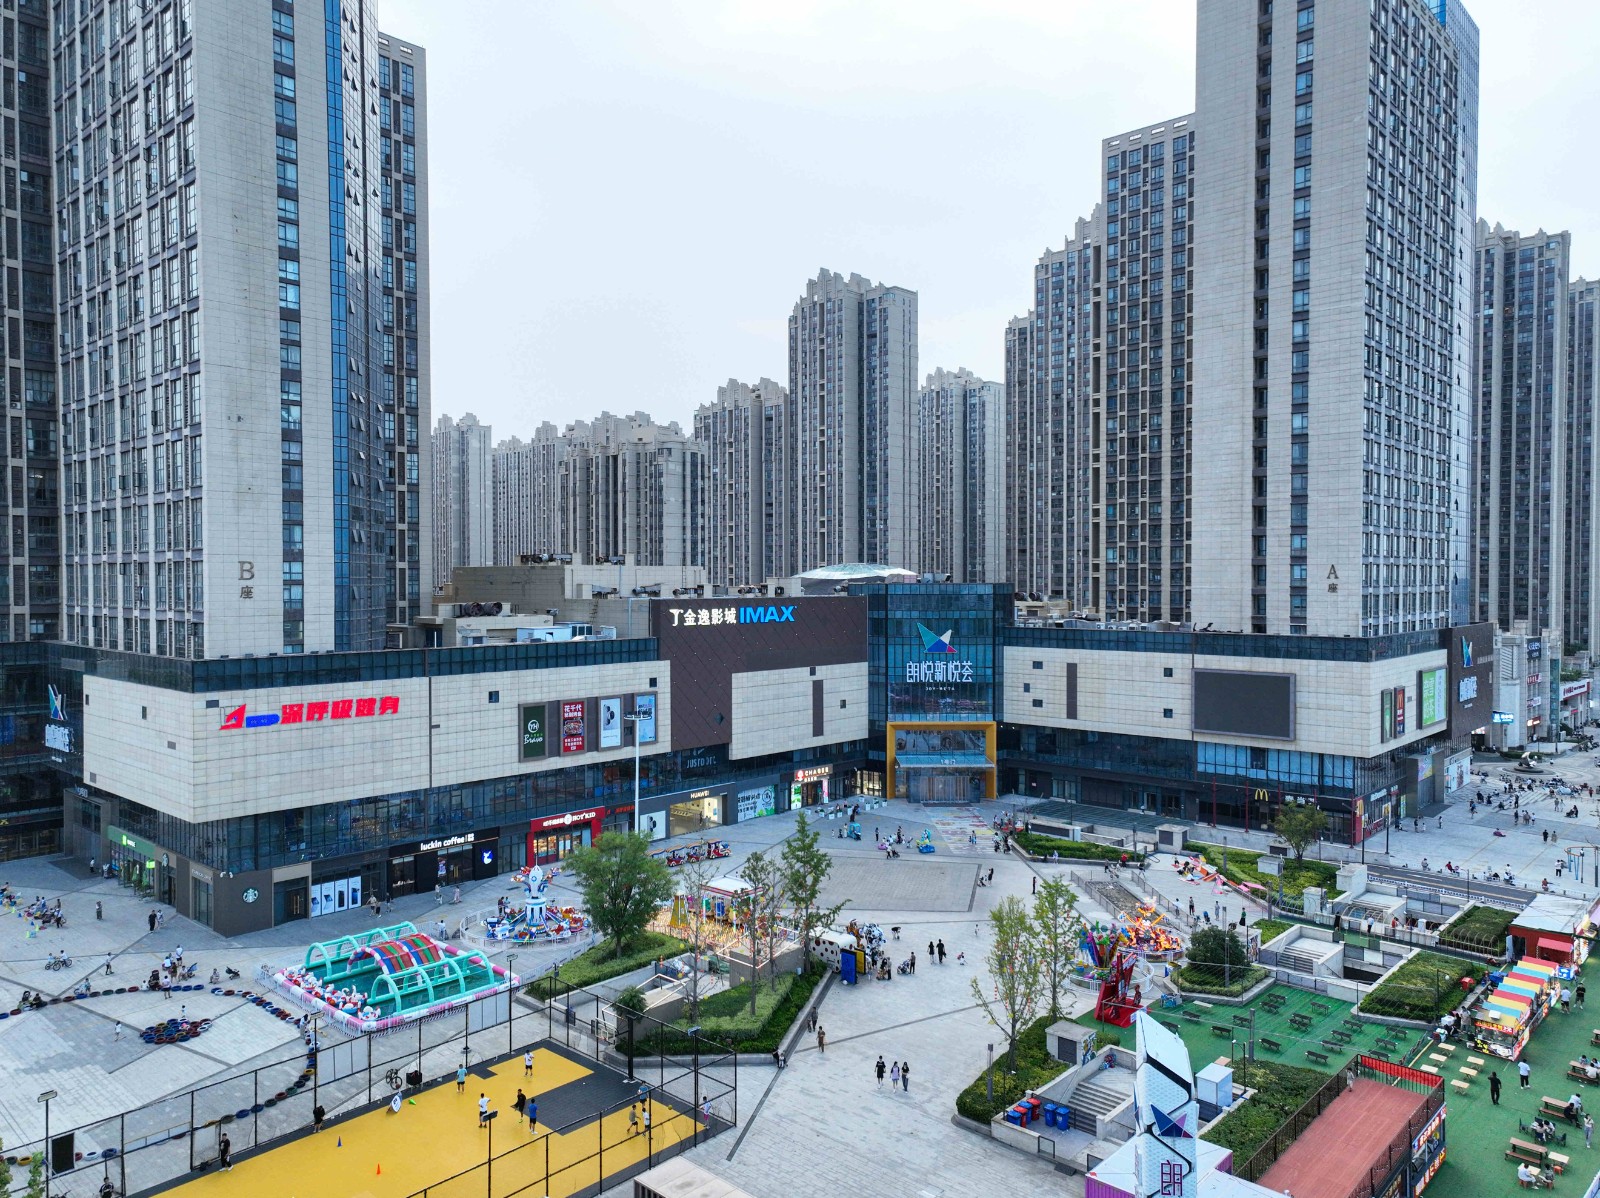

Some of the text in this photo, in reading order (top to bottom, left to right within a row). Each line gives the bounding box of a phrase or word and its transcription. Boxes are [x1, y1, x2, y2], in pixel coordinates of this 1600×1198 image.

[238, 561, 254, 580] B
[1327, 564, 1339, 579] A
[240, 585, 253, 598] 座
[1328, 583, 1338, 593] 座
[684, 606, 795, 626] 金逸影城 IMAX
[906, 660, 973, 682] 朗悦新悦荟
[280, 696, 400, 725] 深呼吸健身
[564, 704, 582, 712] 花千代
[524, 734, 543, 744] Bravo
[690, 791, 710, 799] HUAWEI
[421, 840, 442, 851] luckin
[443, 836, 465, 847] coffee
[1161, 1159, 1183, 1197] 朗
